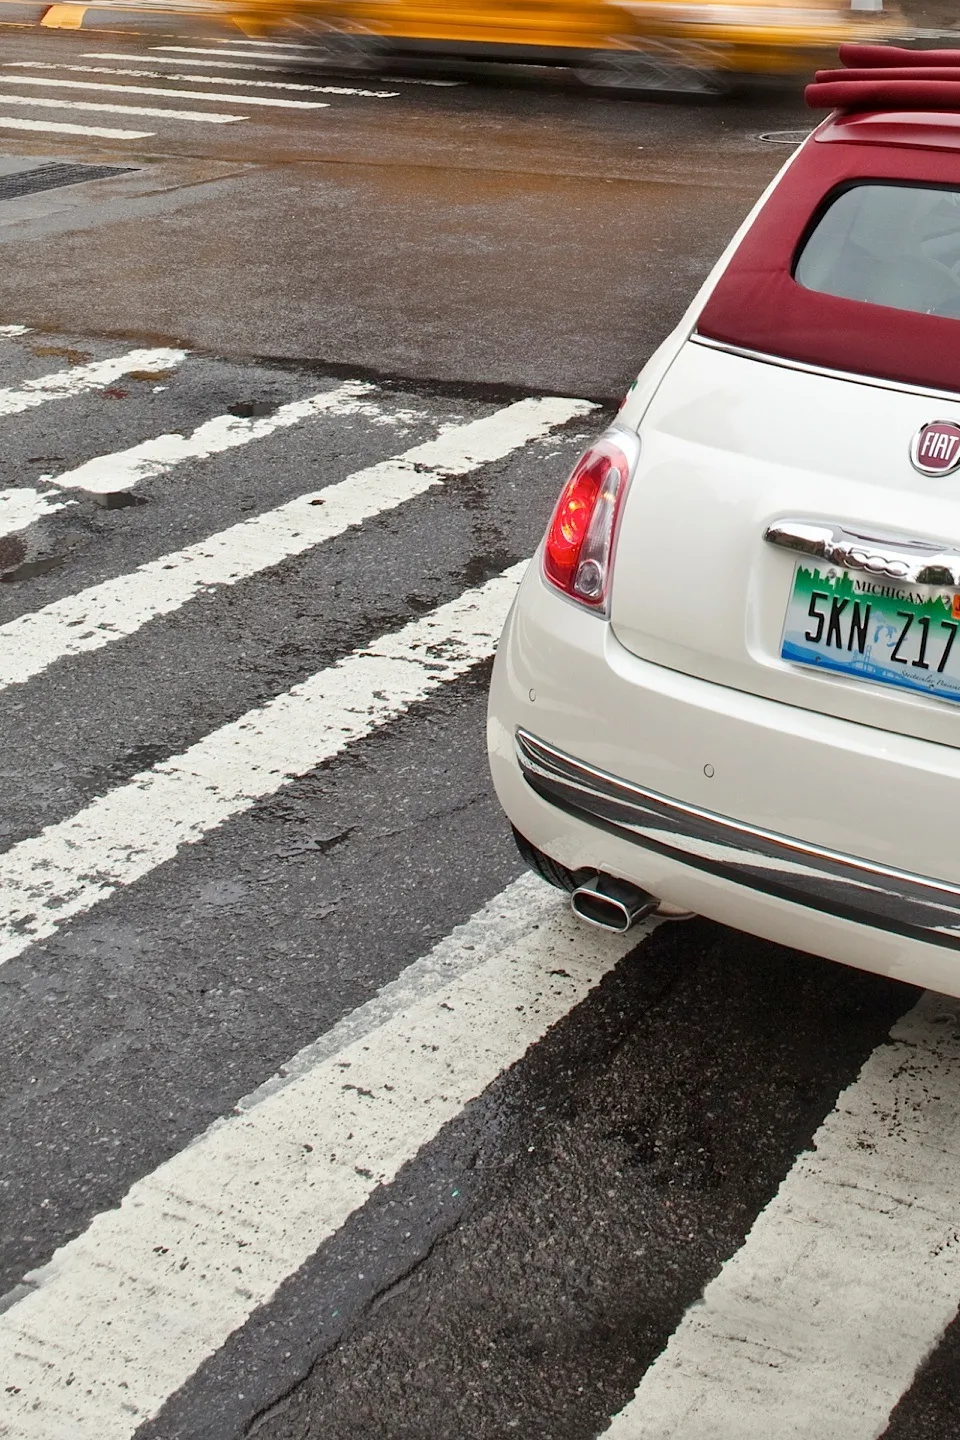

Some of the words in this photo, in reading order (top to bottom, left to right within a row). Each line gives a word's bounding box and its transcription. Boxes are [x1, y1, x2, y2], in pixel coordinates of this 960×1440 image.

[921, 431, 960, 461] FIAT
[843, 547, 911, 579] 500
[854, 580, 926, 604] MICHIGAN
[804, 590, 872, 655] 5KN
[890, 611, 959, 673] Z17
[901, 669, 936, 684] Spectacular
